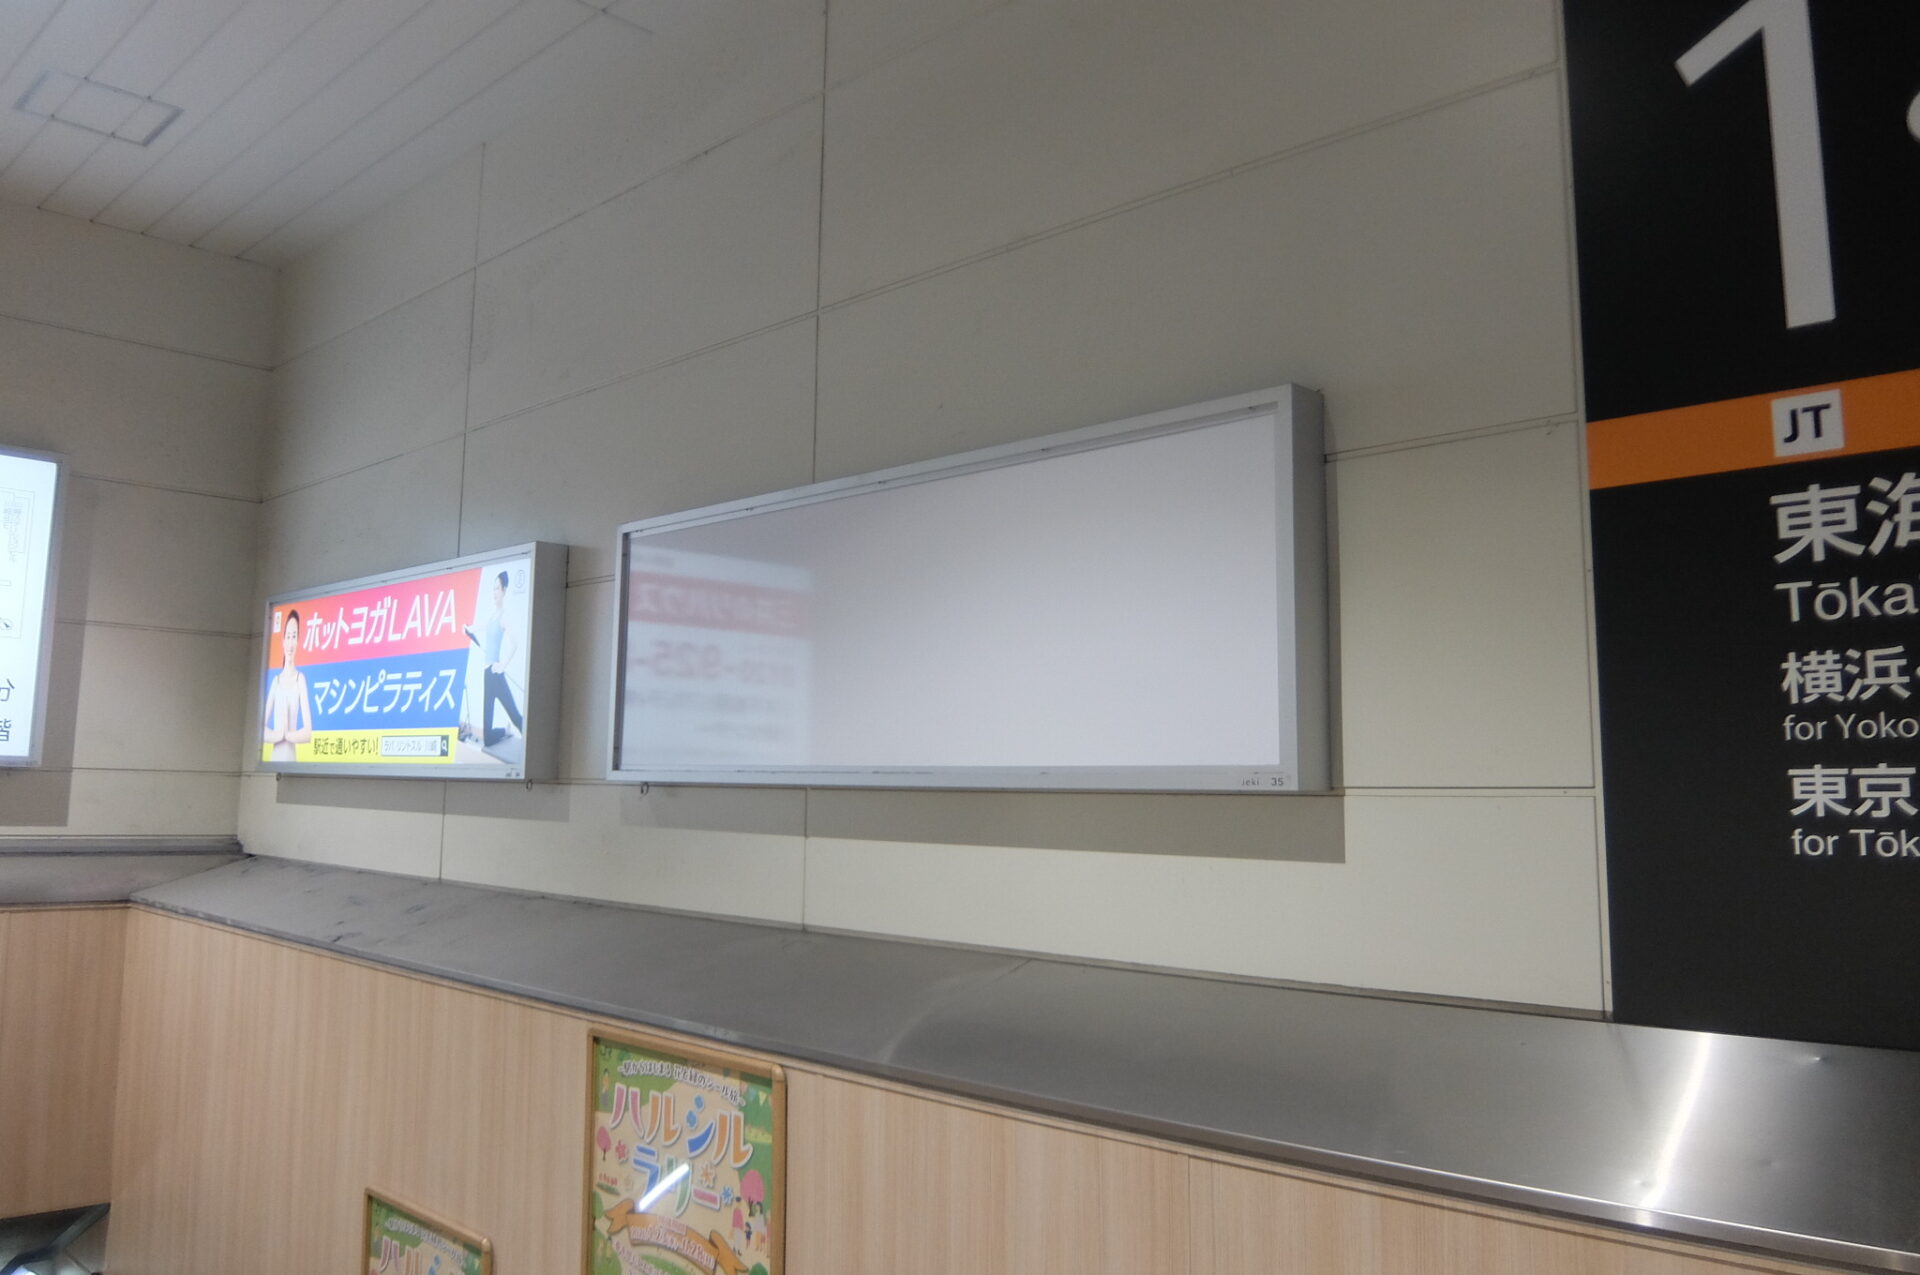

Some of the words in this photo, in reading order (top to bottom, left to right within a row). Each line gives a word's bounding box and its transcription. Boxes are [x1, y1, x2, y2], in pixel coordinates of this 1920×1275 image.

[1674, 0, 1836, 329] 1
[1783, 403, 1831, 443] JT
[303, 589, 456, 651] ホットヨガLAVA
[313, 668, 457, 714] マシンピラティス
[1783, 714, 1827, 741] for
[1835, 711, 1920, 739] Yoko
[1271, 777, 1284, 786] 35
[1787, 763, 1919, 818] 東京
[1791, 828, 1839, 856] for
